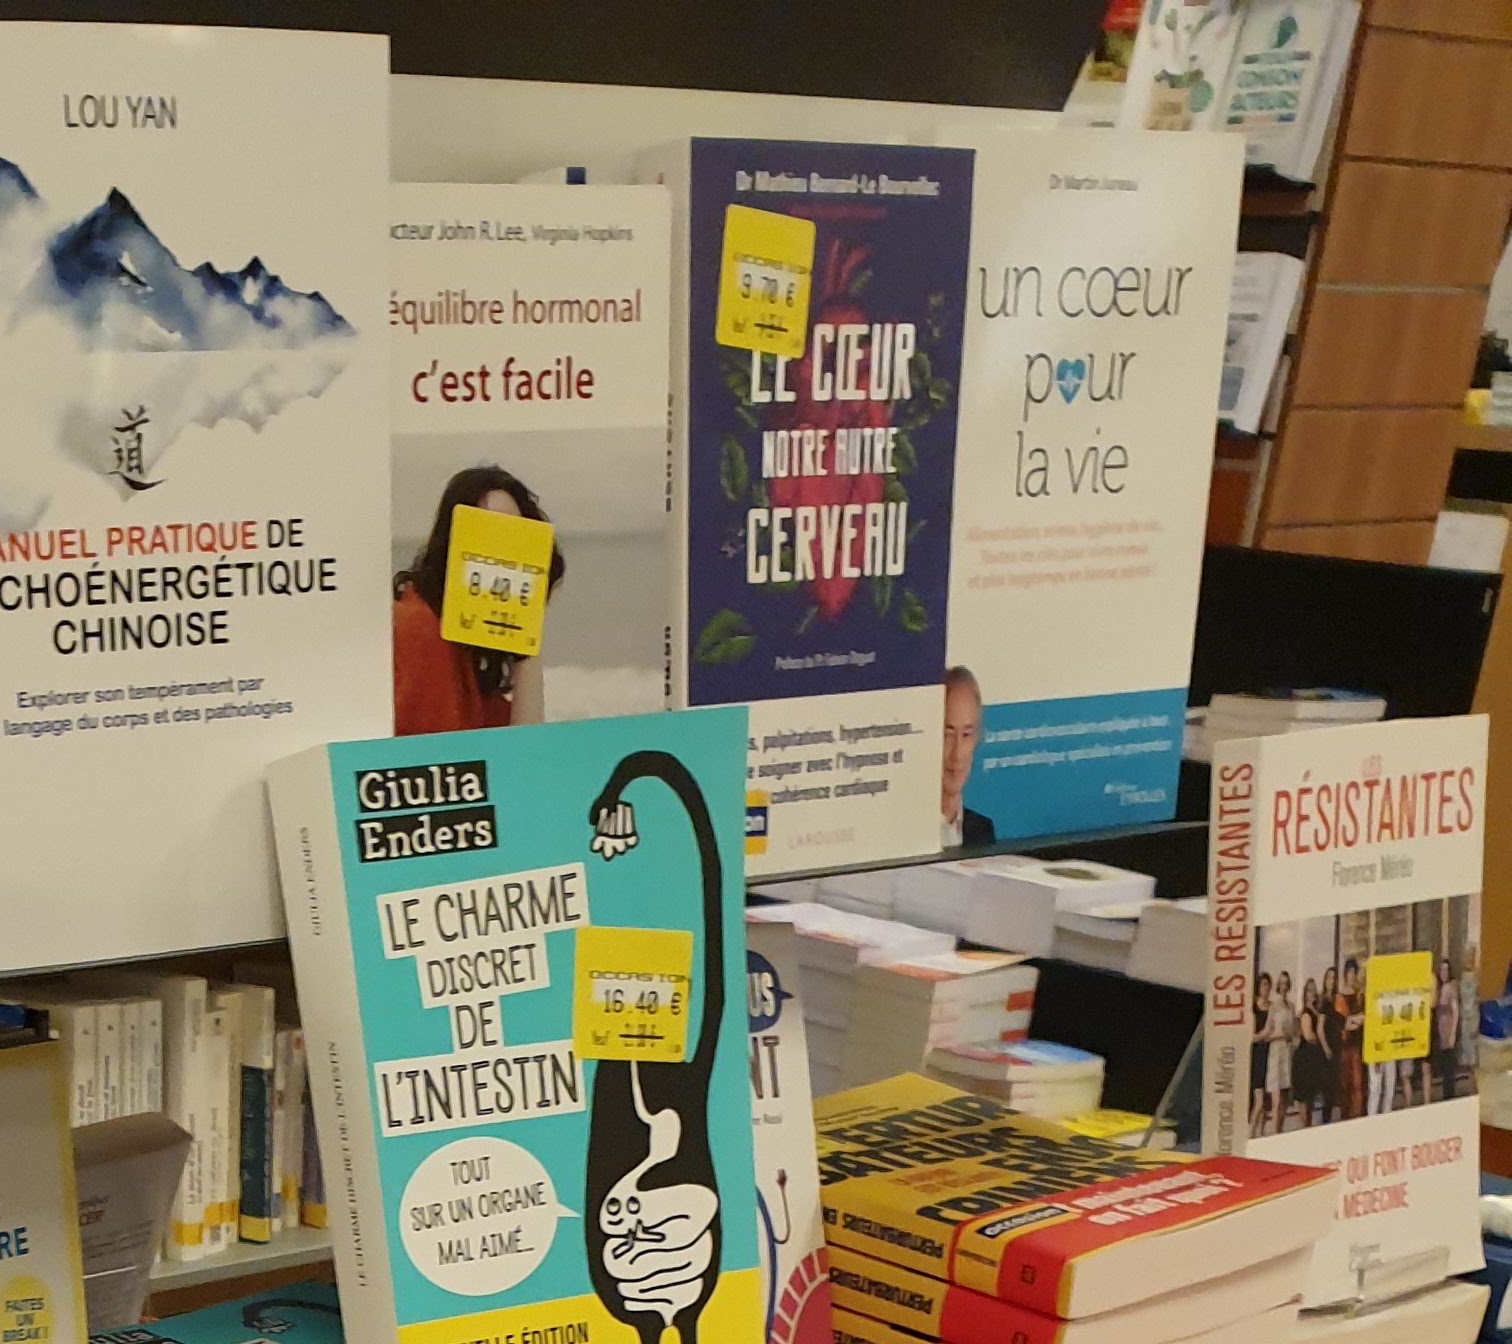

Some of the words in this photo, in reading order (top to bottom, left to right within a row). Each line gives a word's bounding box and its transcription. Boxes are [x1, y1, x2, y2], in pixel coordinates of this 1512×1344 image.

[63, 95, 120, 130] LOU
[127, 96, 178, 130] YAN
[513, 289, 641, 324] hormonal
[979, 265, 1042, 318] un
[1057, 264, 1193, 319] cœur
[412, 360, 490, 403] c'est
[503, 356, 594, 402] facile
[812, 323, 915, 402] CŒUR
[763, 429, 828, 477] NOTRE
[836, 427, 897, 474] AUTRE
[1015, 431, 1050, 498] la
[1066, 428, 1129, 494] vie
[106, 522, 259, 561] PRATIQUE
[266, 519, 304, 548] DE
[746, 502, 908, 583] CERVEAU
[53, 611, 229, 656] CHINOISE
[16, 689, 91, 709] Explorer
[94, 687, 126, 703] son
[128, 679, 231, 703] tempérament
[233, 675, 264, 697] par
[3, 716, 74, 739] langage
[77, 713, 99, 729] du
[102, 710, 149, 734] corps
[153, 710, 169, 725] et
[173, 706, 201, 723] des
[204, 698, 294, 723] pathologies
[357, 769, 485, 810] Giulia
[1271, 766, 1475, 857] RÉSISTANTES
[361, 814, 493, 861] Enders
[385, 898, 425, 953] LE
[434, 871, 581, 944] CHARME
[427, 943, 538, 998] DISCRET
[455, 1001, 496, 1049] DE
[380, 1051, 579, 1129] L'INTESTIN
[448, 1157, 491, 1186] TOUT
[410, 1204, 446, 1232] SUR
[448, 1202, 474, 1223] UN
[477, 1182, 547, 1219] ORGANE
[437, 1240, 474, 1265] MAL
